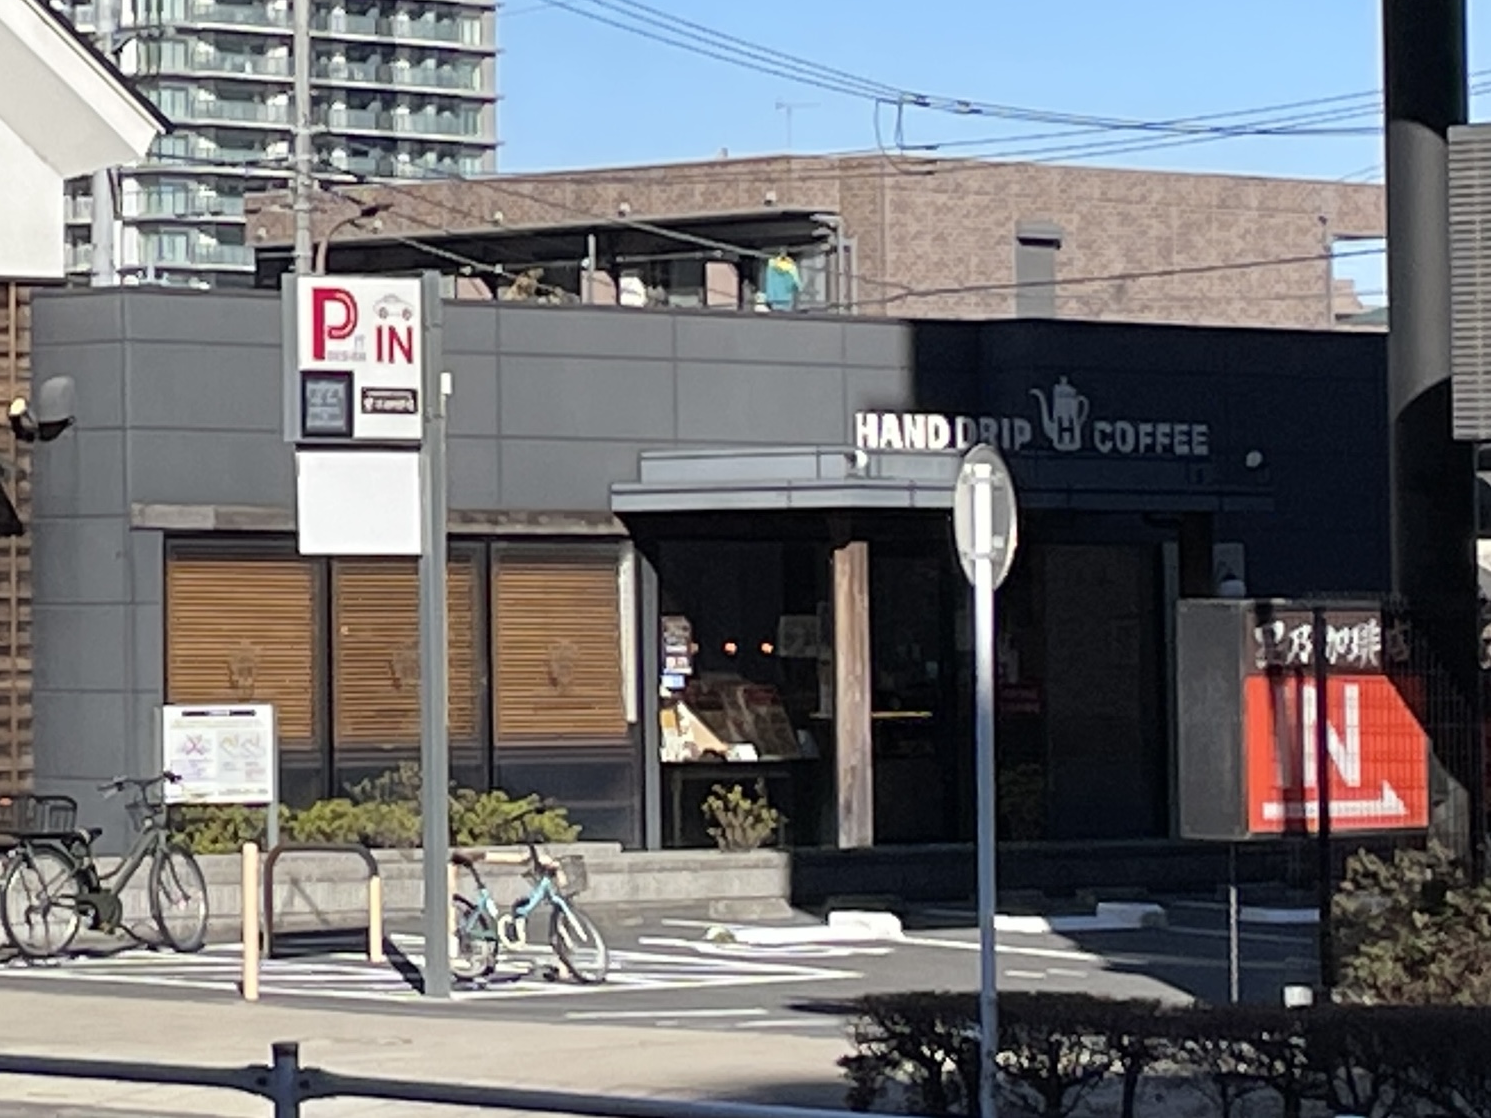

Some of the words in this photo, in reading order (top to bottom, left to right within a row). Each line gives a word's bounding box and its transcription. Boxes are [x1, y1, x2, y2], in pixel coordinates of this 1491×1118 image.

[375, 324, 415, 365] IN
[855, 411, 952, 450] HAND
[955, 413, 1033, 451] DRIP
[1093, 419, 1211, 456] COFFEE
